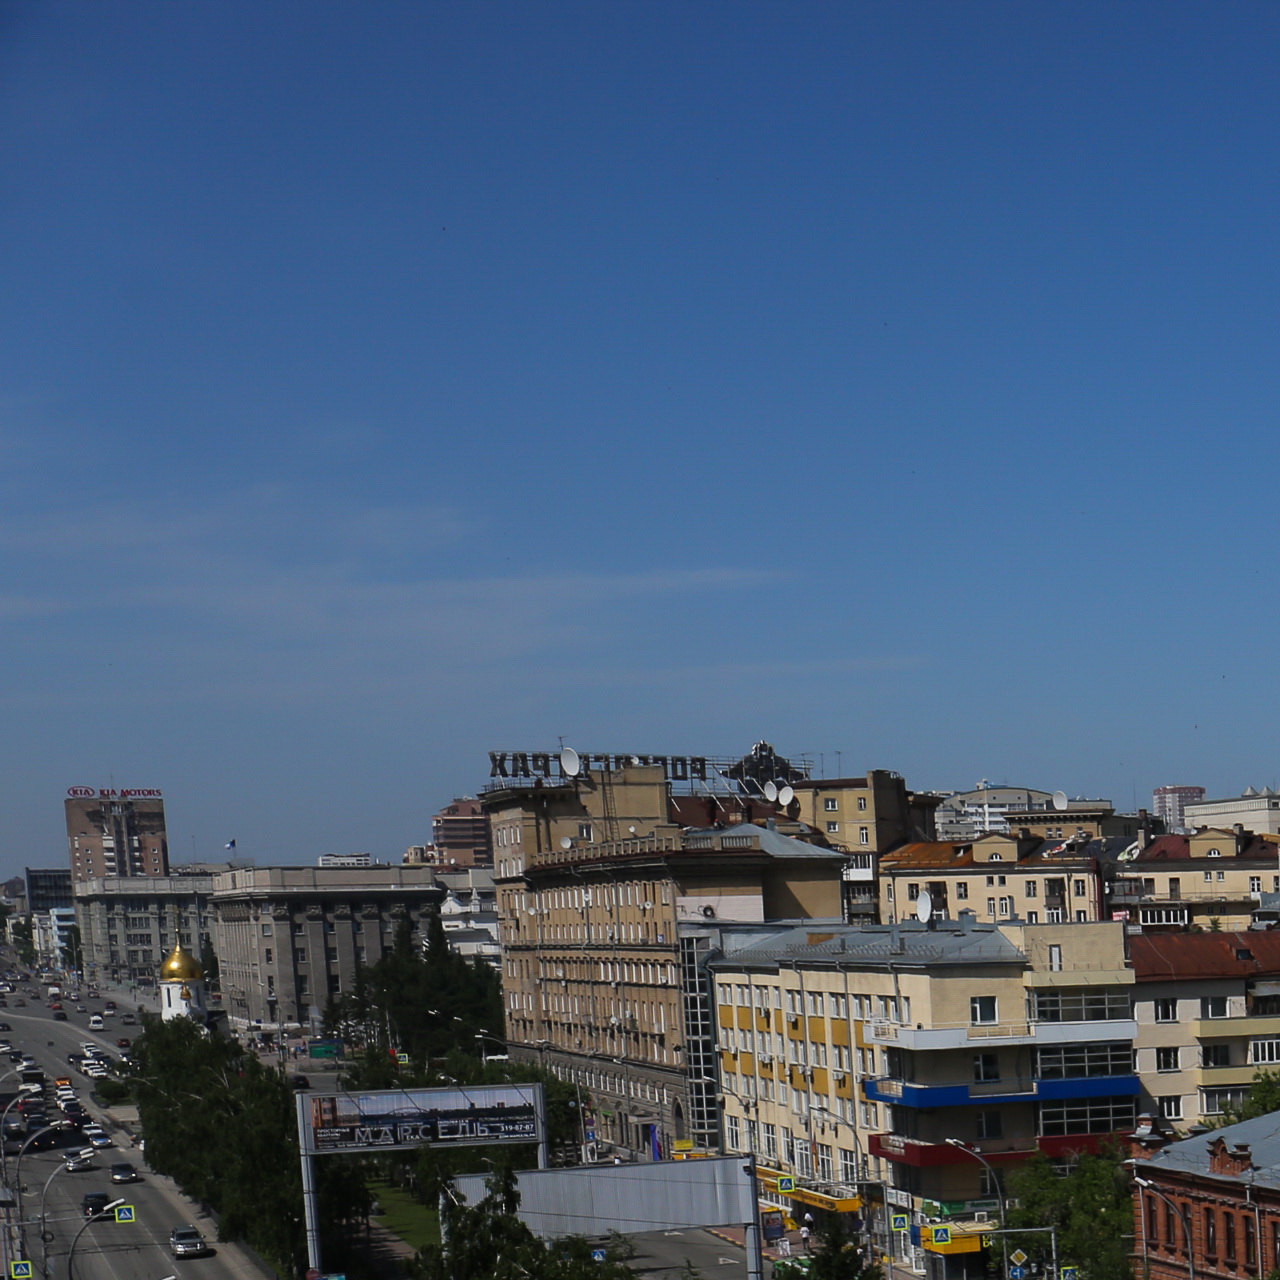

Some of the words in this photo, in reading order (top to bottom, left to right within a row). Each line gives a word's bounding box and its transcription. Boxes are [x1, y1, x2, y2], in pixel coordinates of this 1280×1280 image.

[99, 788, 117, 796] KIA
[120, 788, 162, 797] MOTORS
[355, 1121, 489, 1142] МАРСЕЛЬ
